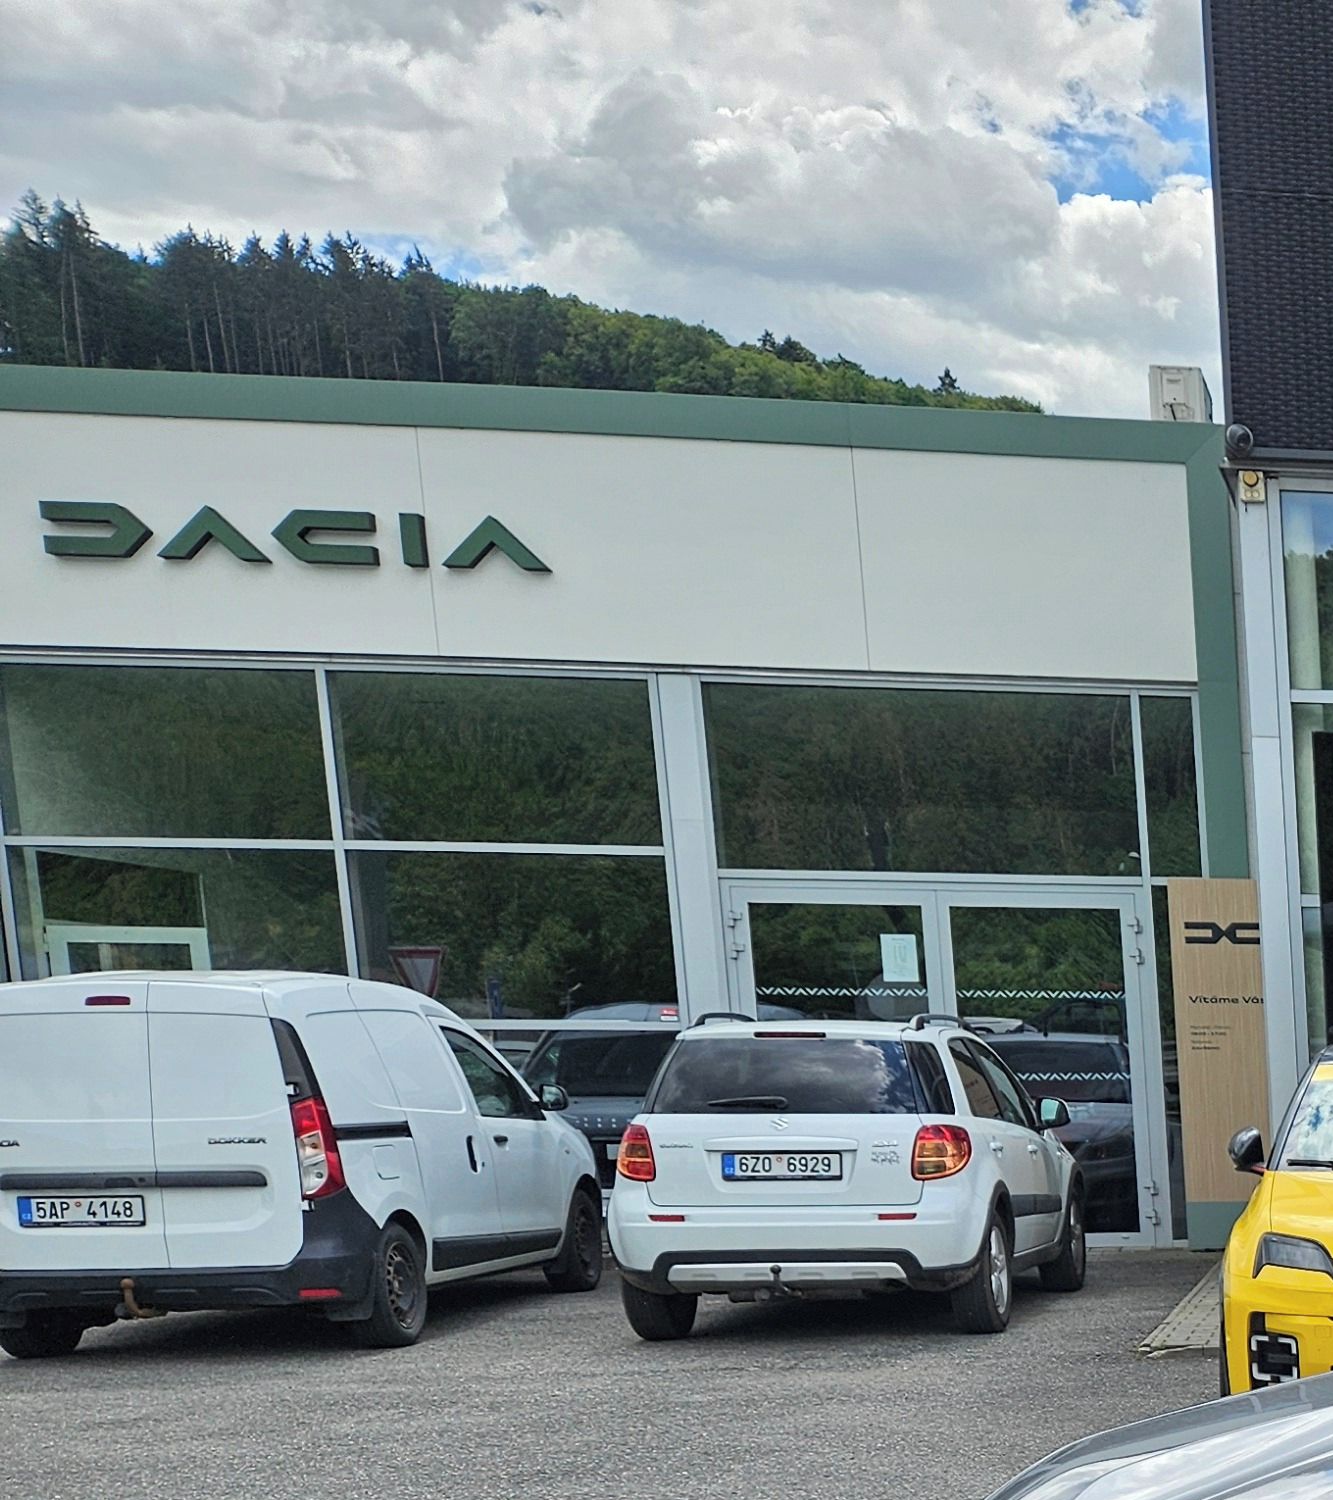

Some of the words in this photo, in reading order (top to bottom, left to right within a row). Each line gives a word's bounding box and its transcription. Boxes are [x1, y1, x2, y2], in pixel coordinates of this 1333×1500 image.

[38, 500, 553, 573] DACIA
[738, 1156, 772, 1172] 6Z0
[787, 1156, 832, 1173] 6929
[36, 1201, 70, 1219] 5AP
[87, 1201, 134, 1219] 4148
